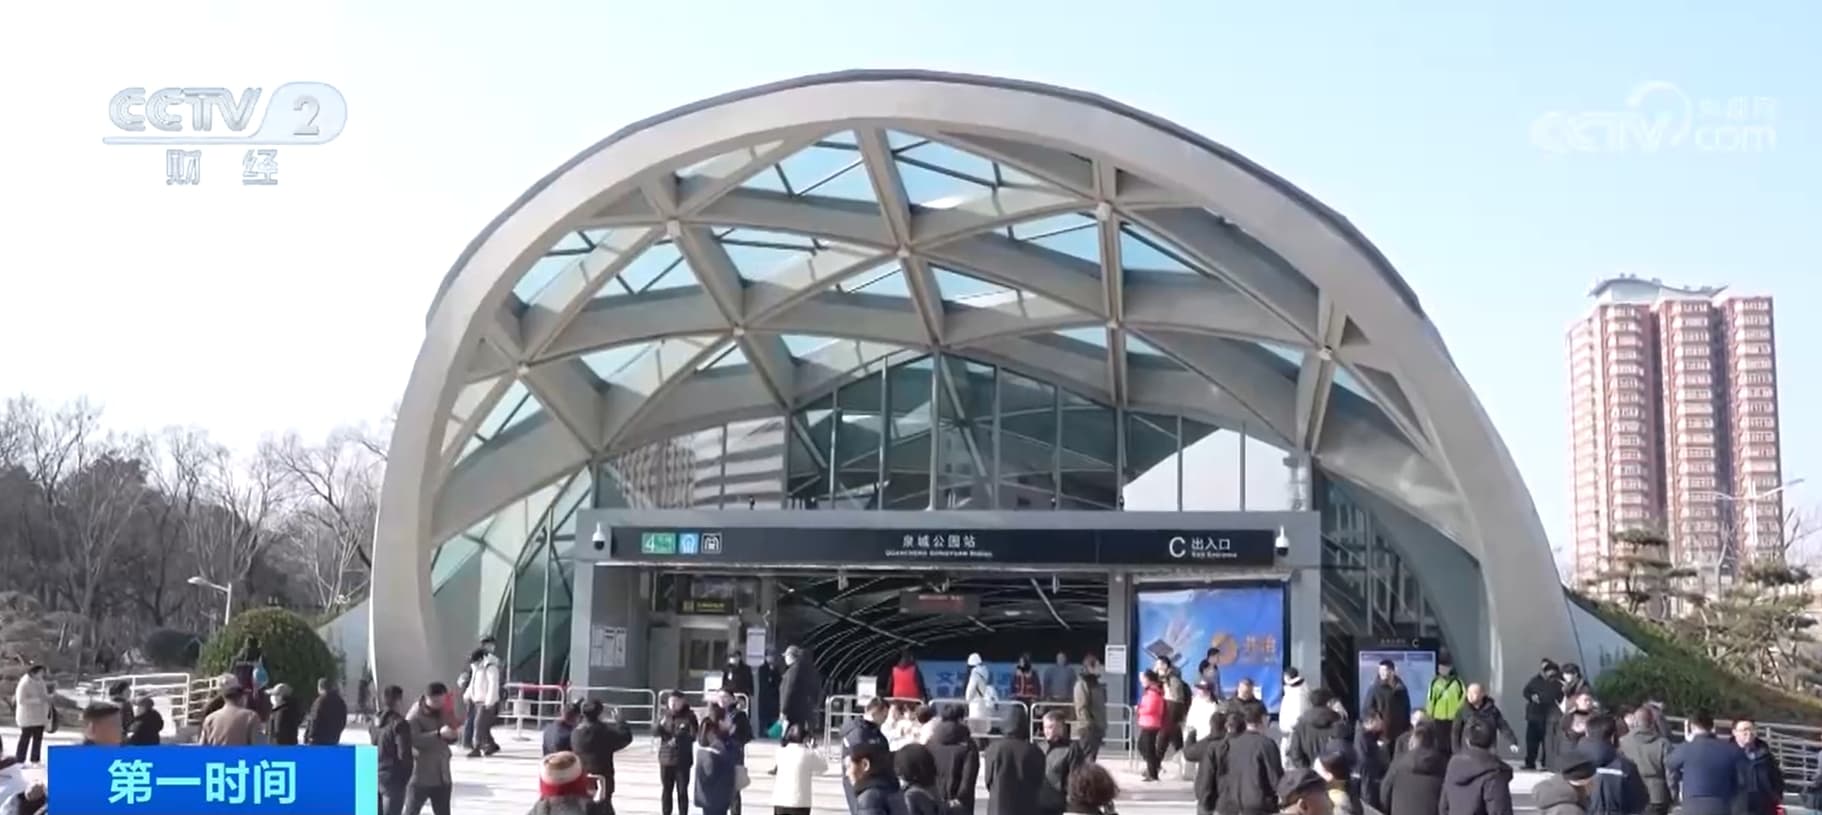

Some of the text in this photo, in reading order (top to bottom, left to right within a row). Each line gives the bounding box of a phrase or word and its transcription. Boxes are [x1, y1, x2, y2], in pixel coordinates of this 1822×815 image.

[903, 534, 976, 549] 泉城公园站
[1168, 536, 1186, 558] C
[1191, 537, 1231, 550] 出入口
